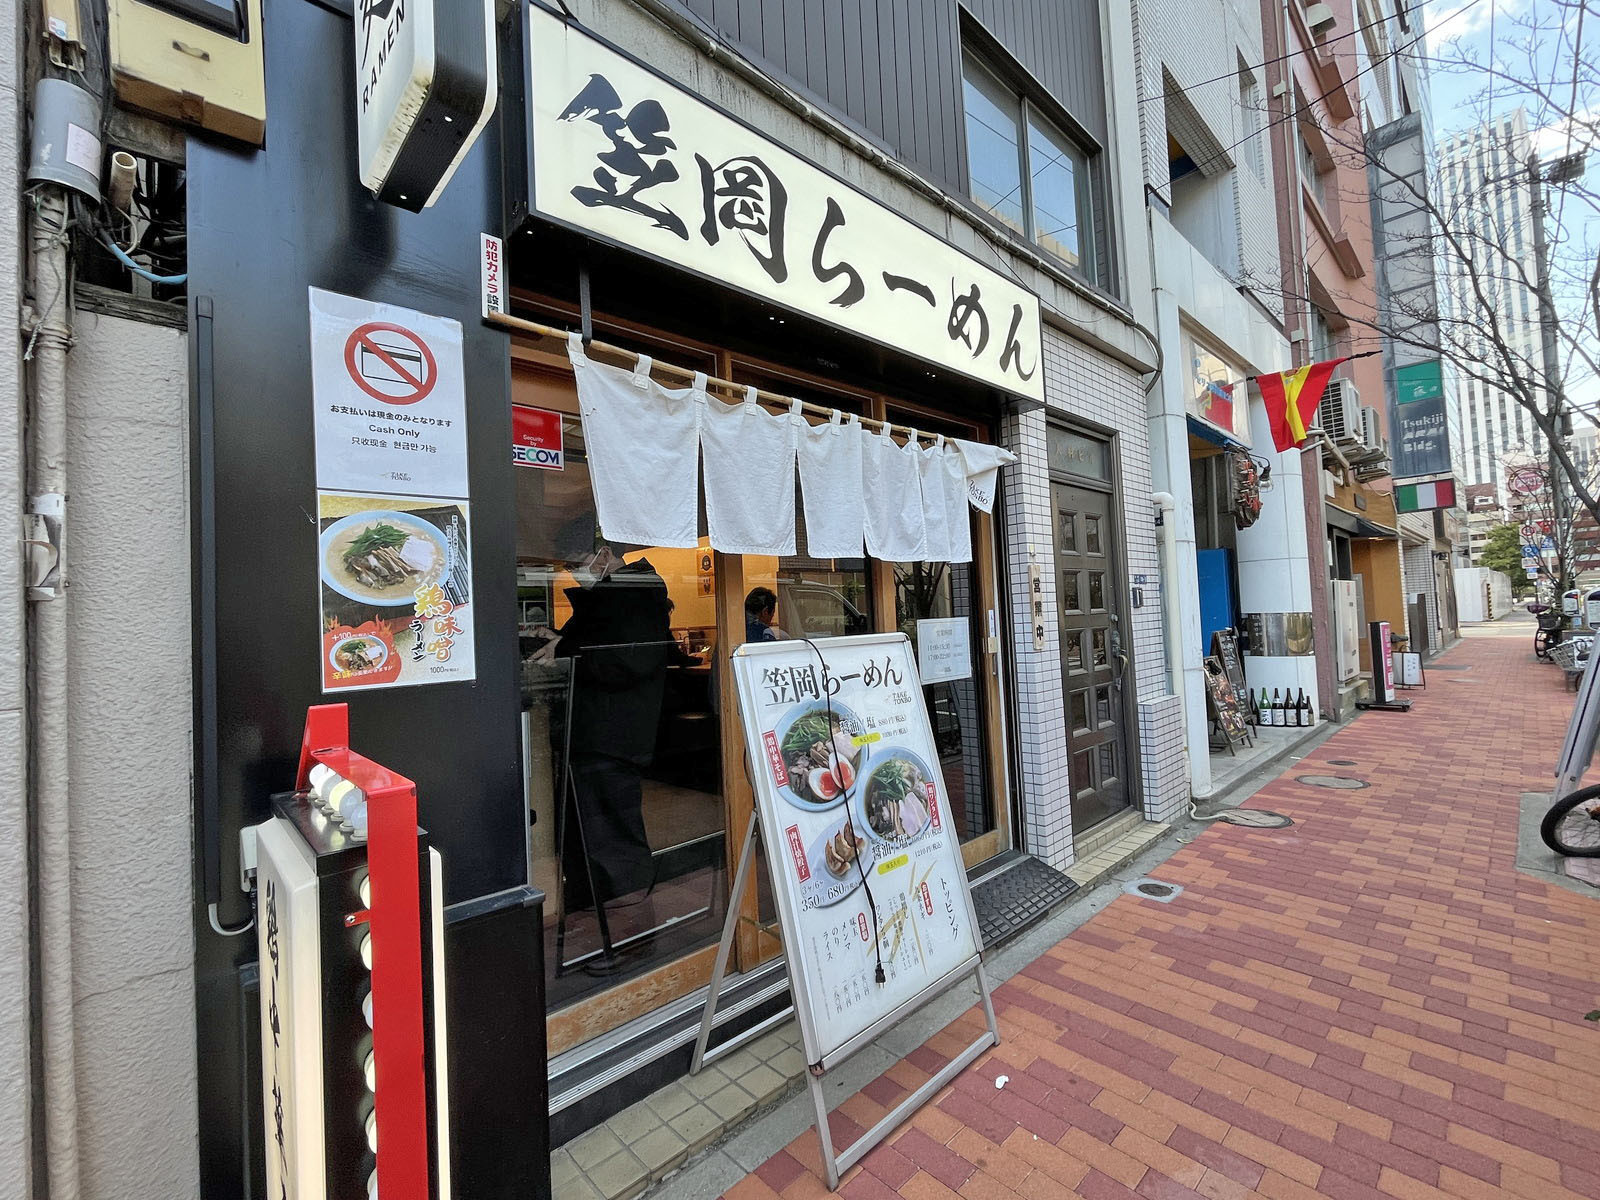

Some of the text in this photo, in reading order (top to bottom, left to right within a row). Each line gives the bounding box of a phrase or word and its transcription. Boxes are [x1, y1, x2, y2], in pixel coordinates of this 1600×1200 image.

[361, 0, 405, 113] RAMEN
[556, 72, 1038, 382] 笠岡らーめん
[330, 404, 453, 428] お支払いは現金のみとなります
[1401, 412, 1444, 429] Tsukiji
[351, 436, 437, 454] 只收现金 현금만 가능
[368, 424, 420, 439] Cash Only
[523, 434, 545, 443] Security
[414, 582, 463, 661] 鶏味噌
[1033, 577, 1044, 641] 営業中
[410, 620, 424, 661] ラーメン
[760, 655, 903, 708] 笠岡らーめん
[940, 877, 959, 943] トッピング
[823, 931, 834, 961] ライス
[832, 927, 840, 946] のり
[842, 921, 851, 951] メンマ
